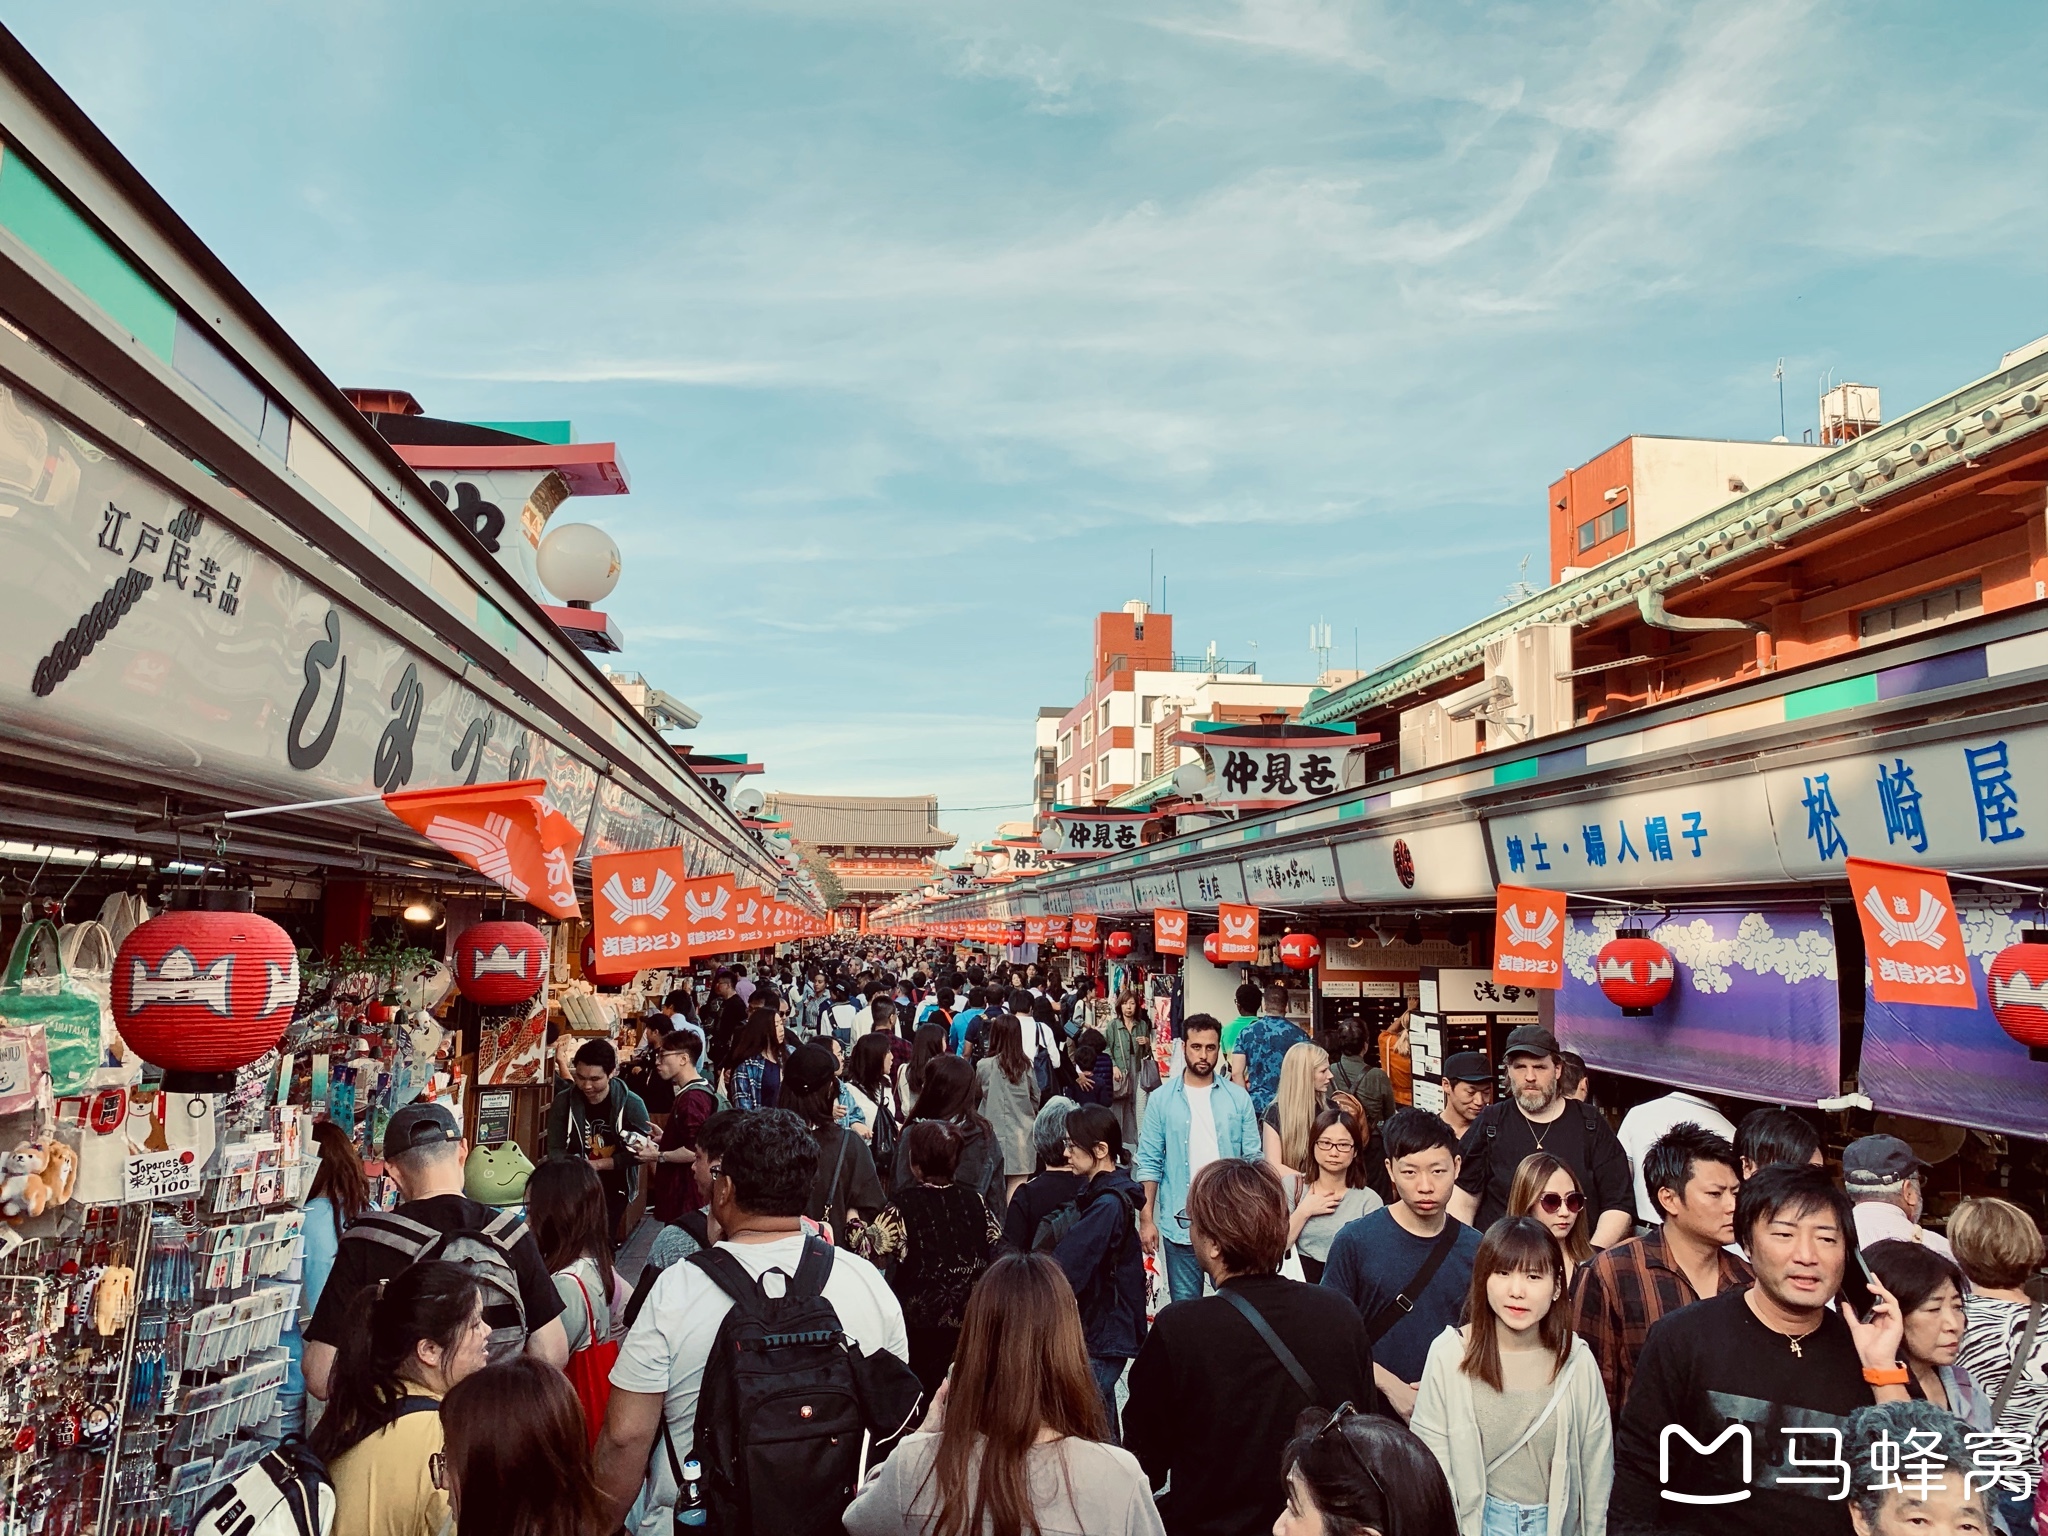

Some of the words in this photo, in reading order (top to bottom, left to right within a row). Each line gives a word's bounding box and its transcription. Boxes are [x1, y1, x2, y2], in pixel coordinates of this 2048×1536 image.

[99, 502, 241, 616] 江戸民芸品
[1801, 741, 2026, 861] 松崎屋
[1506, 811, 1708, 873] 紳士・婦人帽子
[1499, 953, 1558, 974] 浅草おどり
[1877, 957, 1966, 986] 浅草おどり
[129, 1172, 160, 1189] 柴犬
[160, 1164, 195, 1179] Dog
